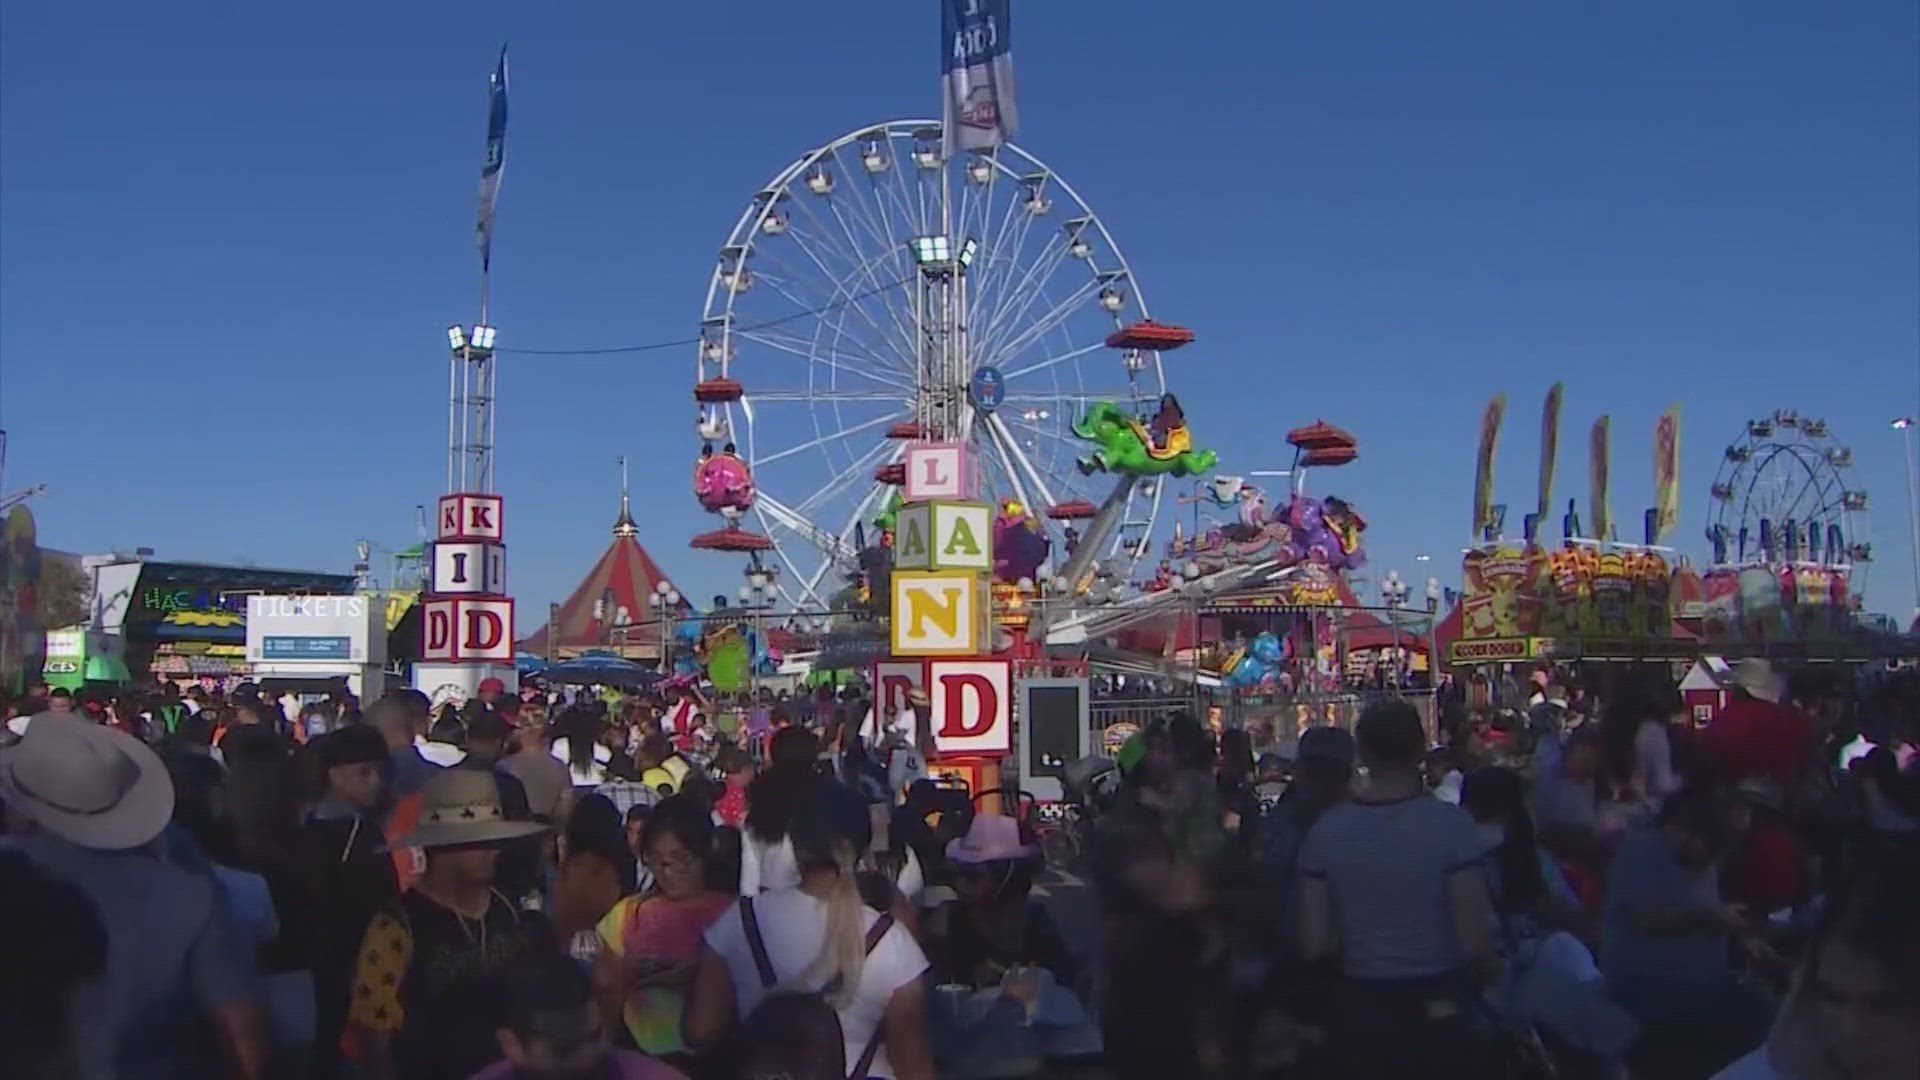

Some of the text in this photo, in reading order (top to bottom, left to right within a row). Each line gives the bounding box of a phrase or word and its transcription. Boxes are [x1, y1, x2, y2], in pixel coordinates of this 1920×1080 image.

[924, 458, 948, 486] L
[470, 506, 493, 528] K
[902, 517, 925, 556] A
[944, 516, 981, 555] A
[452, 553, 467, 583] I
[255, 596, 363, 617] TICKETS
[905, 587, 961, 639] N
[429, 611, 448, 650] D
[464, 609, 502, 650] D
[938, 673, 998, 738] D
